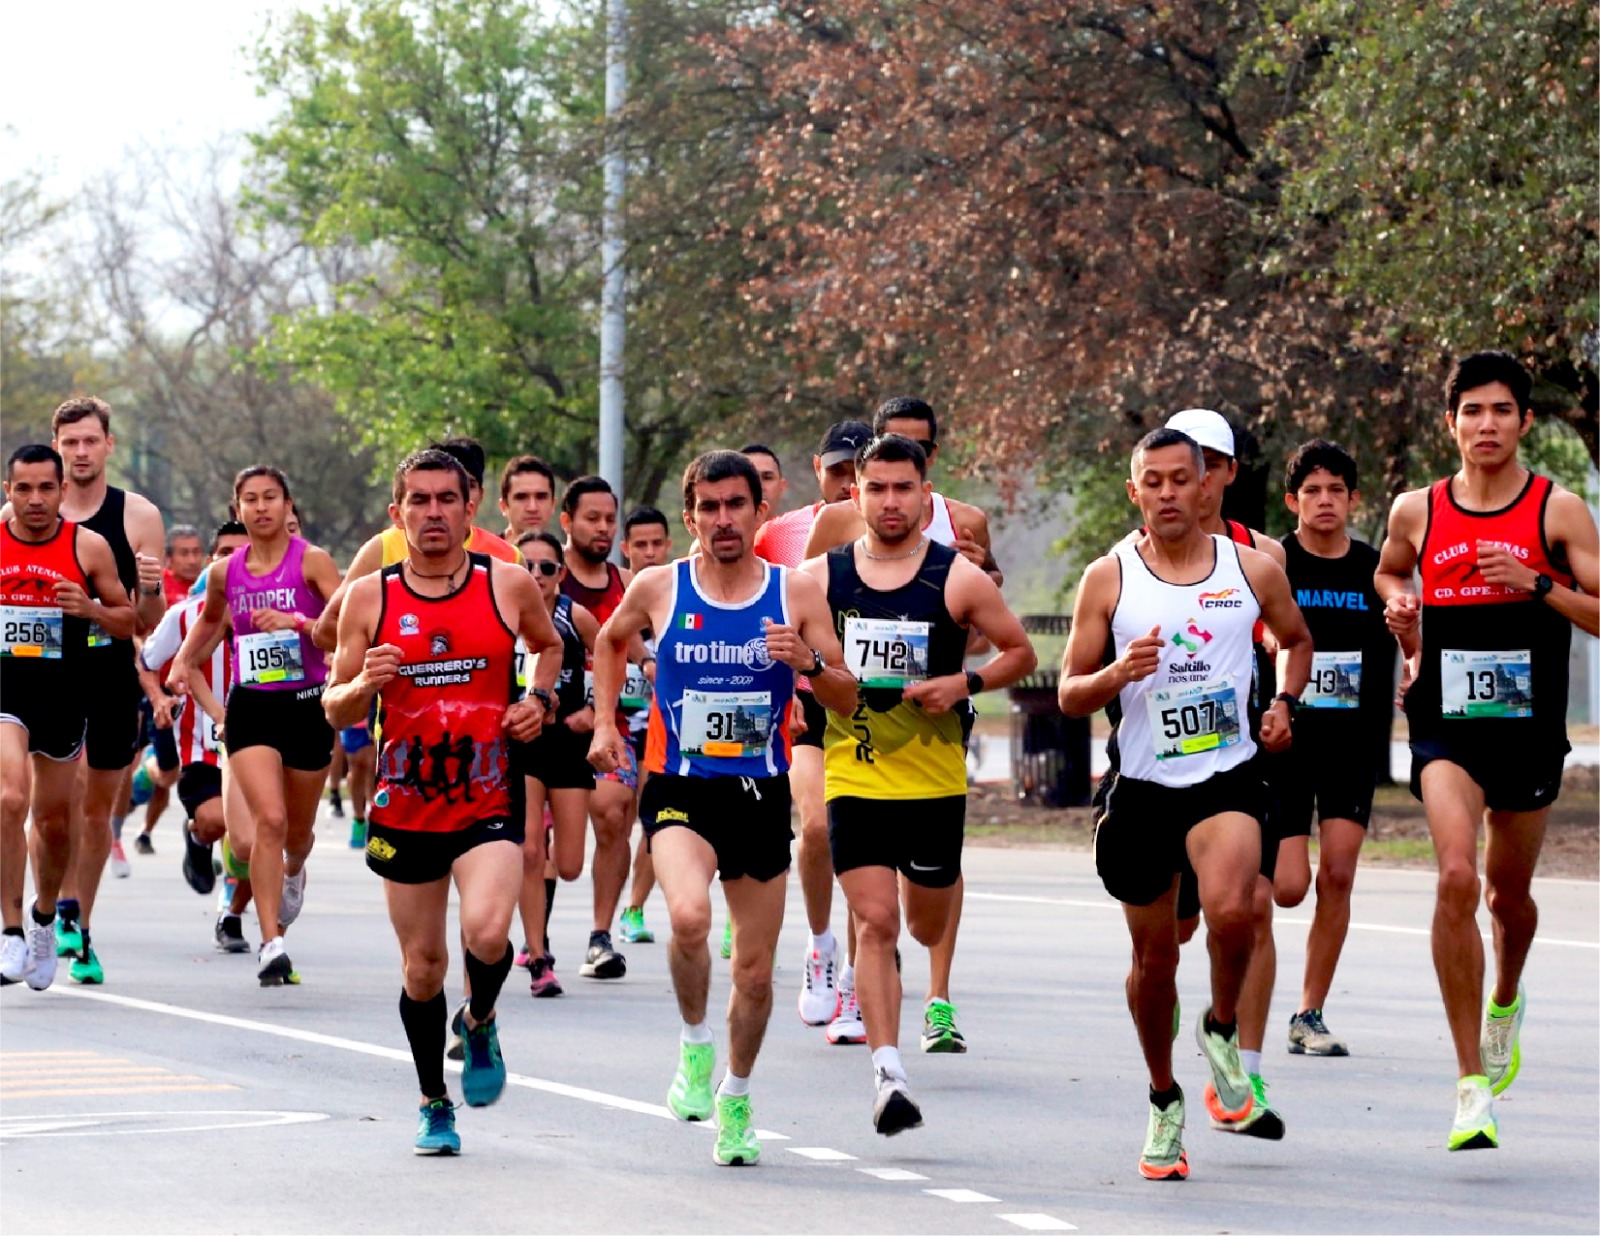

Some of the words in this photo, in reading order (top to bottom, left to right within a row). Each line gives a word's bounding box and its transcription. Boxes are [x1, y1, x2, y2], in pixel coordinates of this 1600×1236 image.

[1433, 542, 1469, 564] CLUB
[1486, 540, 1529, 559] ENAS
[0, 565, 20, 576] LUB
[1296, 589, 1369, 610] MARVEL
[1434, 587, 1456, 599] CD.
[1204, 600, 1243, 608] CROC
[5, 622, 46, 643] 256
[249, 646, 284, 671] 195
[856, 639, 907, 670] 742
[398, 658, 488, 676] GUERRERO'S
[1168, 660, 1211, 674] Saltillo
[414, 672, 471, 687] RUNNERS
[697, 675, 724, 685] since
[1168, 675, 1188, 683] nos
[1466, 671, 1495, 700] 13
[296, 686, 320, 701] NIKE
[706, 711, 734, 740] 31
[1161, 700, 1216, 739] 507
